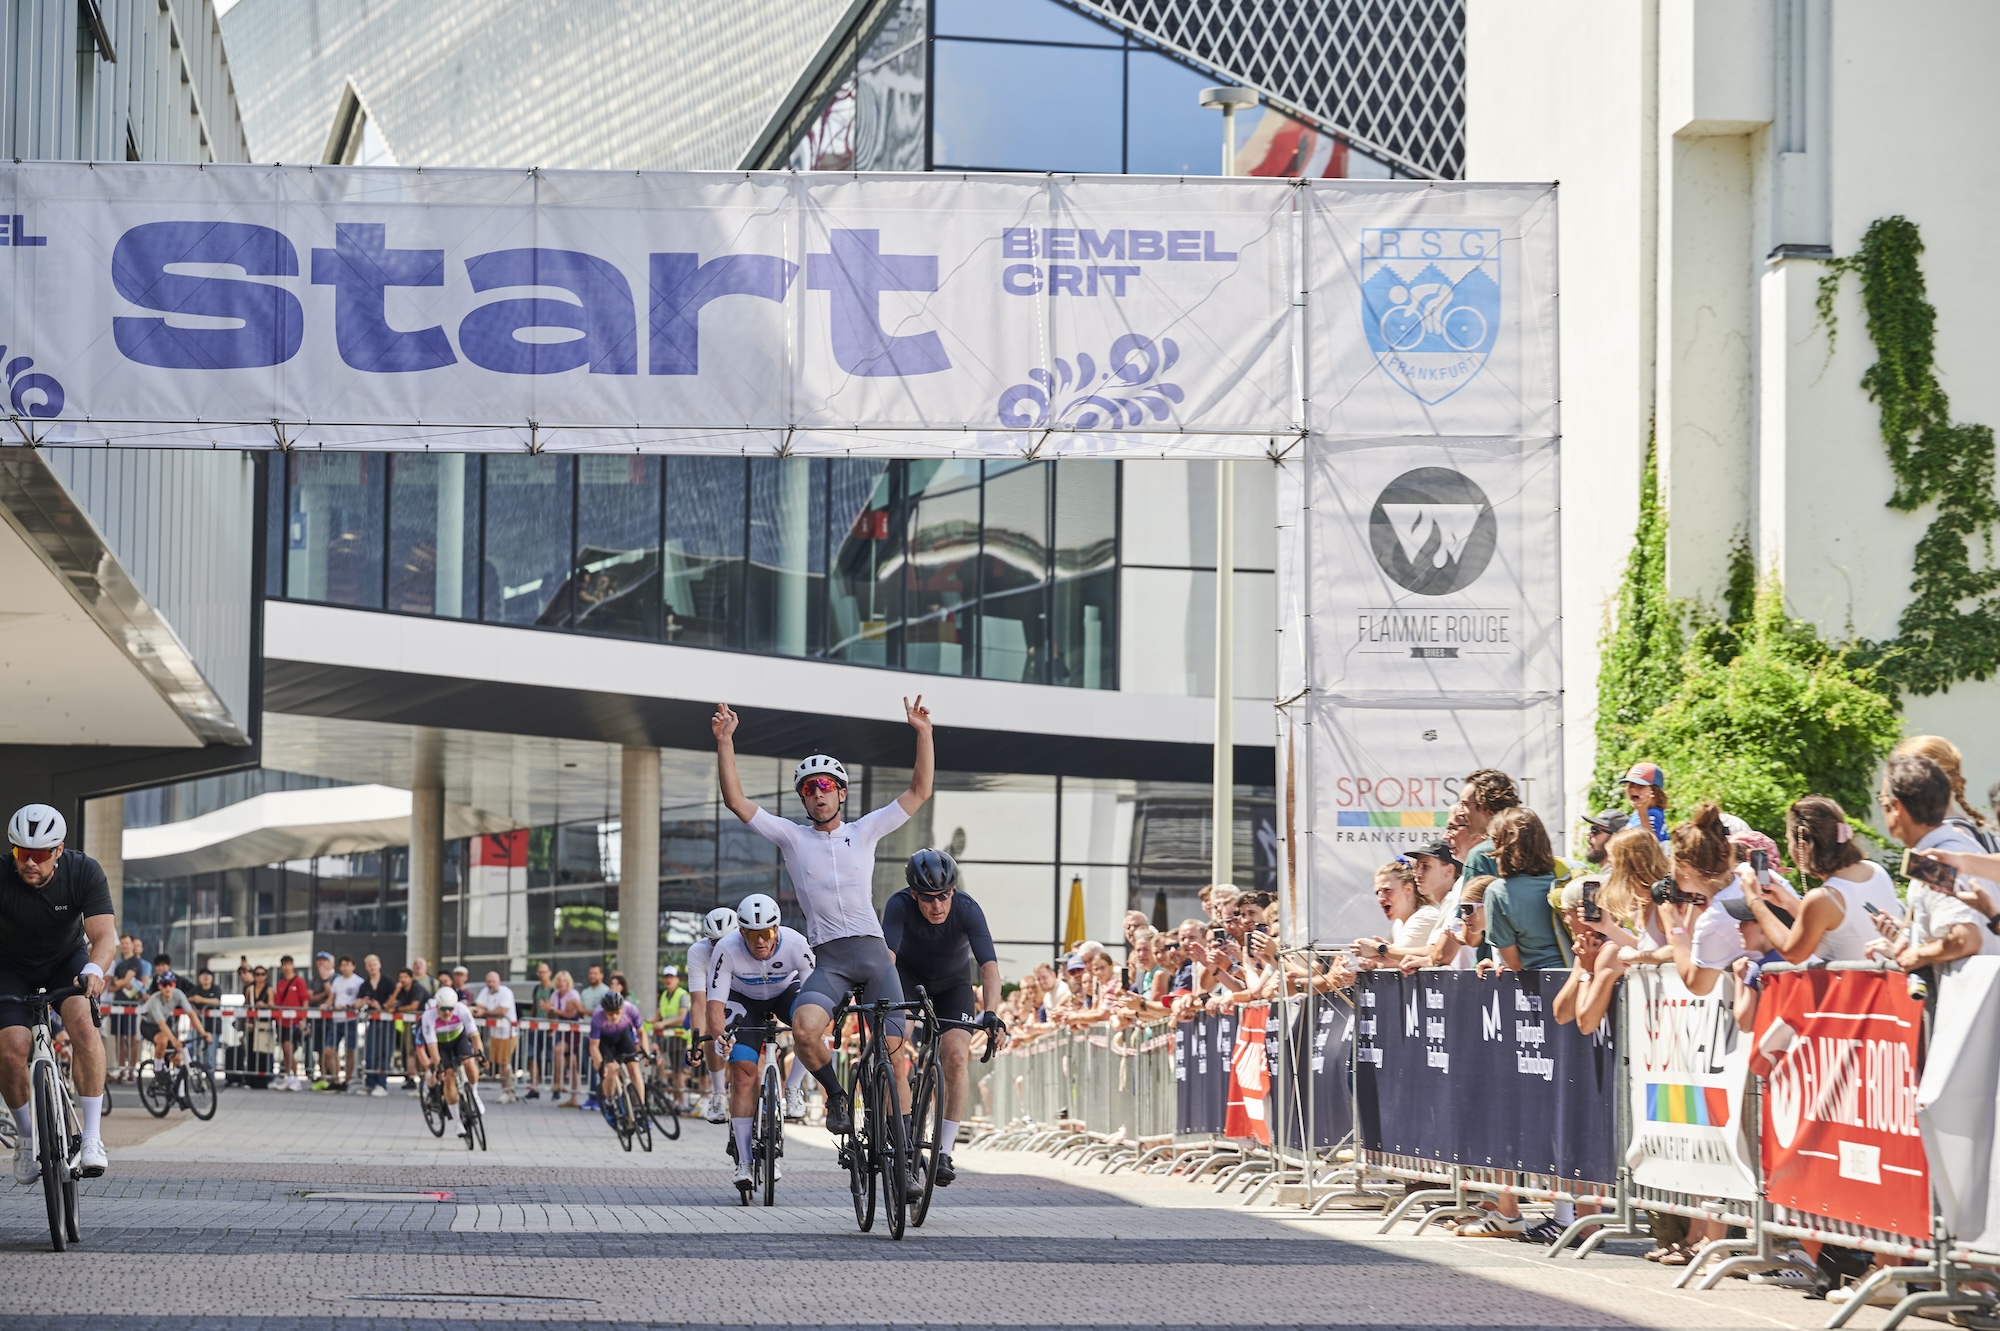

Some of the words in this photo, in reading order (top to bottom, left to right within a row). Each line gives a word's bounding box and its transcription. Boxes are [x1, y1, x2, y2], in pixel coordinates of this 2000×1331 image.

[1002, 227, 1238, 262] BEMBEL
[1002, 264, 1141, 298] CRIT
[111, 221, 953, 377] Start
[1387, 356, 1478, 381] FRANKFURT
[1358, 615, 1439, 643] FLAMME
[1446, 615, 1509, 644] ROUGE
[1336, 777, 1536, 808] SPORTST
